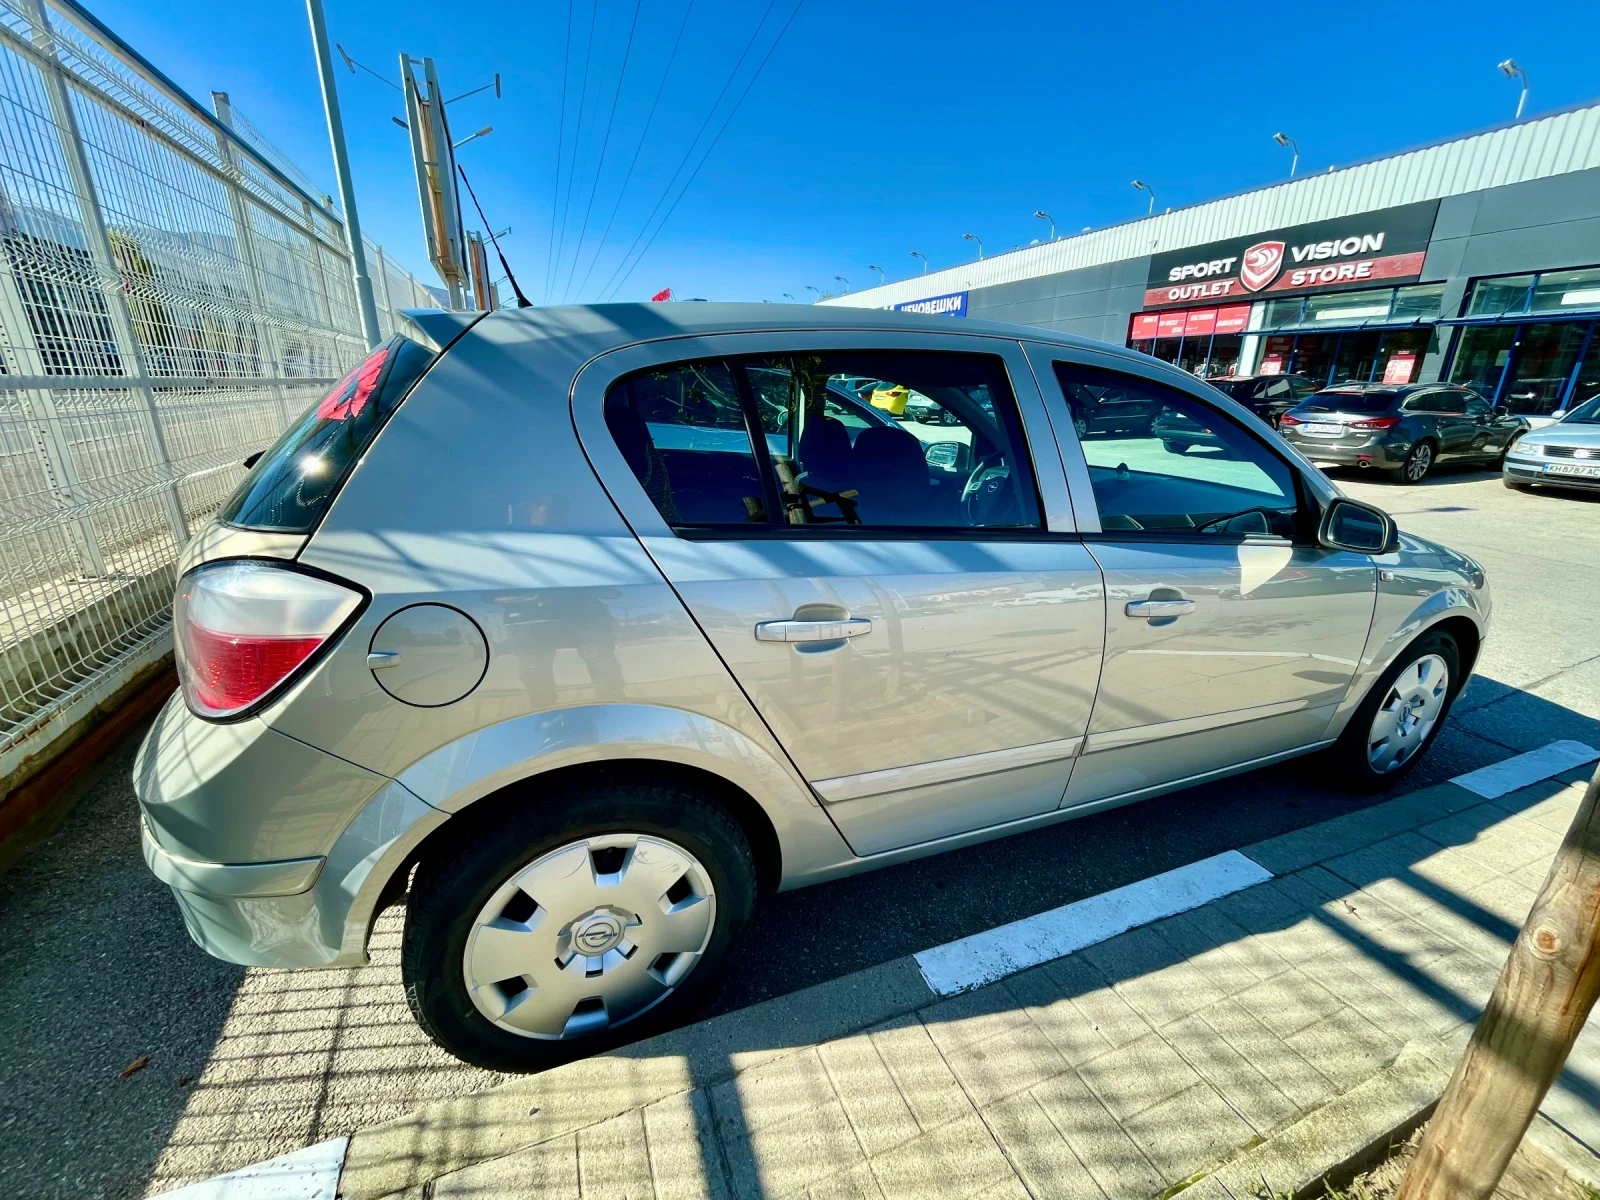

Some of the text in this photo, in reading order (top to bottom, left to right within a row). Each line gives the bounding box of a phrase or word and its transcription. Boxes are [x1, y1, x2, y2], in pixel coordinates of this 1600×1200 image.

[1168, 232, 1385, 282] SPORT VISION
[1168, 262, 1374, 301] OUTLET STORE
